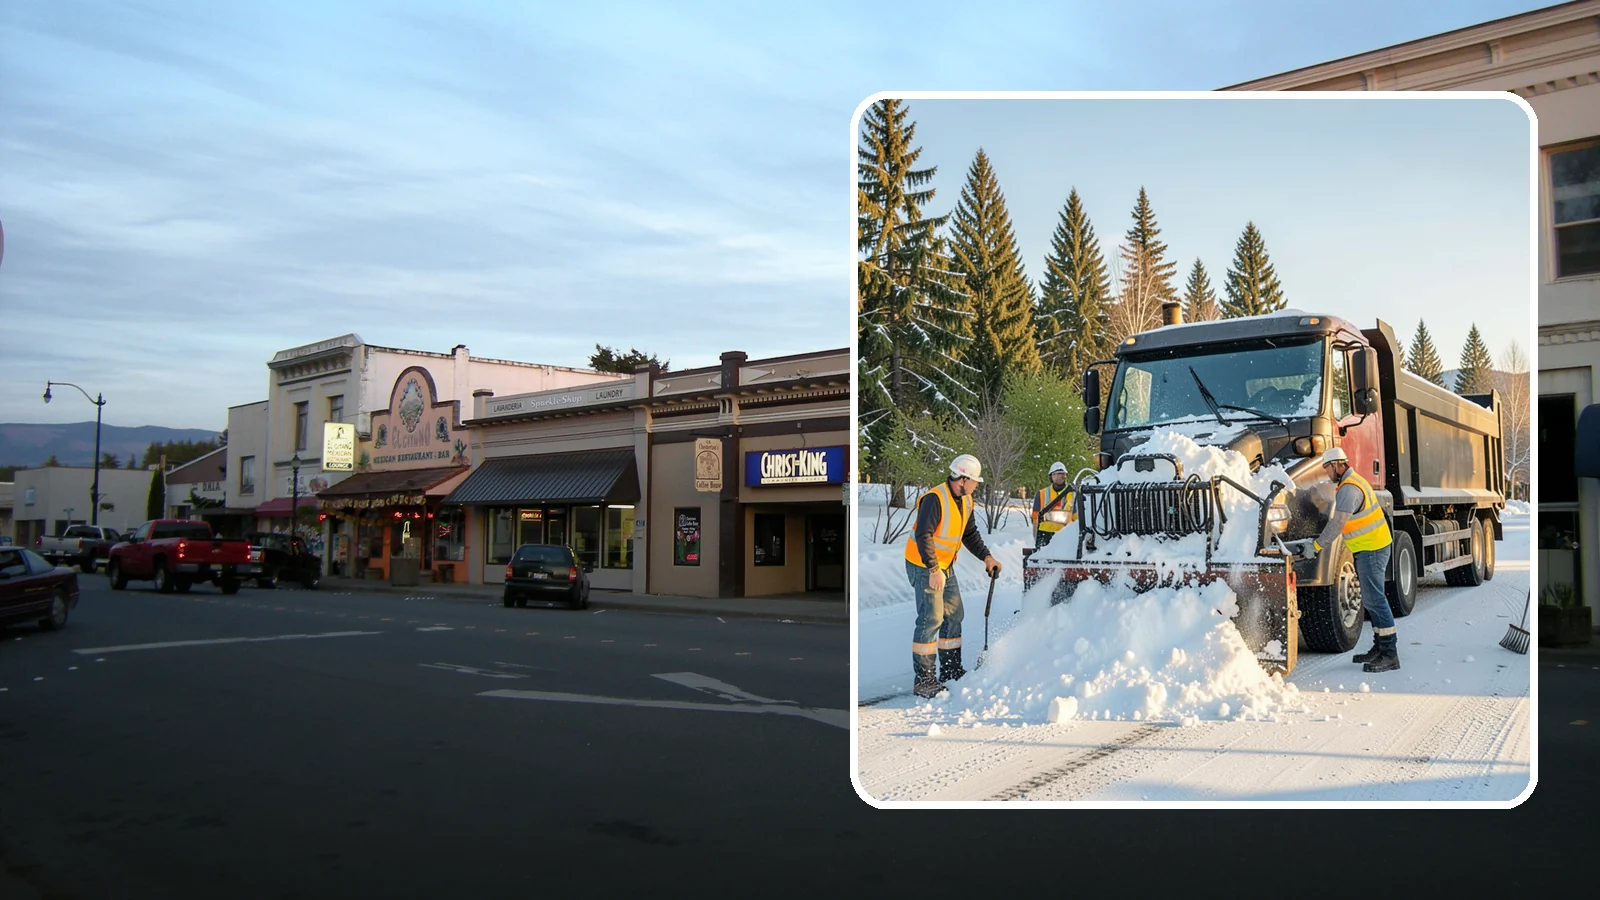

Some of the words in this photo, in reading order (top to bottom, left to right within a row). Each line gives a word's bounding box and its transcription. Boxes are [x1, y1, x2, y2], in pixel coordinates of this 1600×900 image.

[531, 395, 560, 409] Sparkle
[562, 394, 582, 404] Shop
[595, 389, 623, 400] LAUNDRY
[493, 402, 522, 413] LAVANDERIA
[373, 455, 396, 464] MEXICAN
[397, 451, 433, 462] RESTAURANT
[438, 450, 450, 459] BAR
[761, 452, 797, 478] CHRIST
[798, 450, 827, 476] KING
